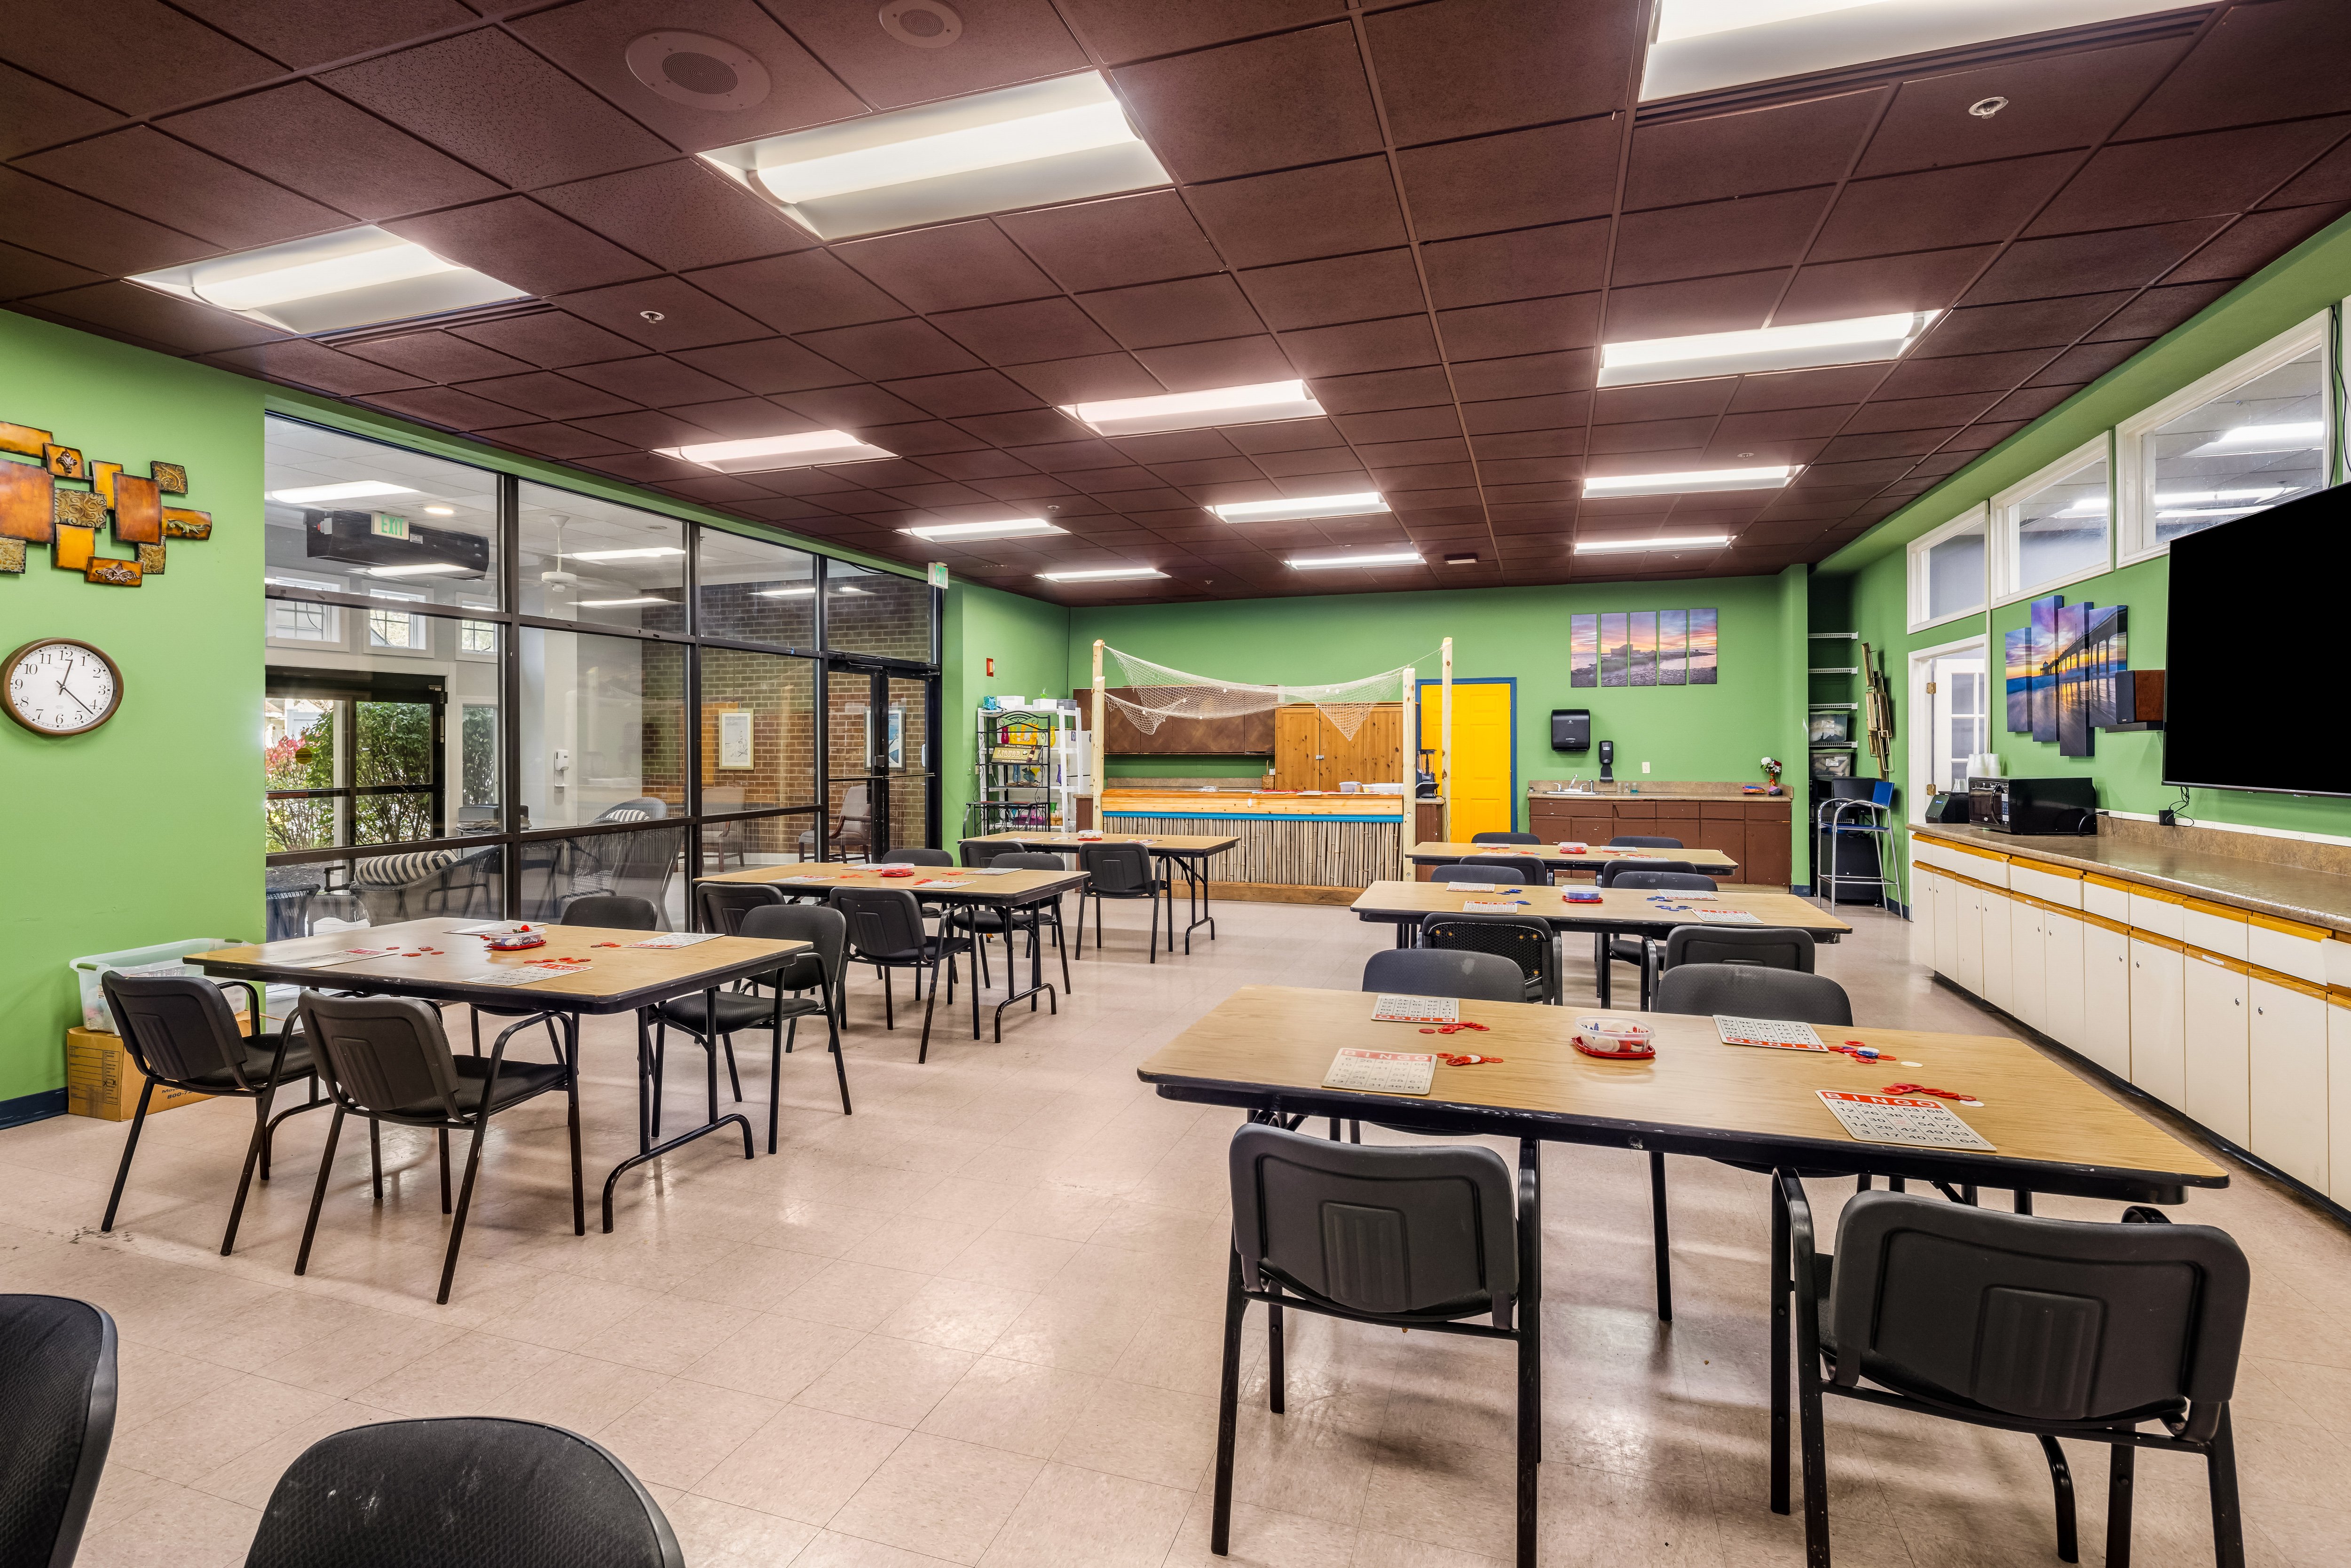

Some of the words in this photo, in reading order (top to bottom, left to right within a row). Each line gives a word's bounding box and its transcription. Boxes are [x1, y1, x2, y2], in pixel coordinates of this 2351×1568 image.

[381, 515, 404, 536] EXIT
[935, 565, 947, 586] EXIT
[39, 654, 52, 664] 11
[59, 650, 73, 661] 12
[80, 656, 87, 666] 1
[23, 664, 38, 675] 10
[93, 668, 101, 678] 2
[15, 679, 23, 690] 9
[98, 685, 106, 695] 3
[20, 696, 29, 707] 8
[89, 700, 97, 709] 4
[35, 709, 44, 719] 7
[56, 714, 63, 725] 6
[75, 711, 83, 721] 5
[997, 749, 1020, 758] LIQUOR
[1730, 1038, 1820, 1049] BINGO
[1344, 1049, 1428, 1060] BINGO
[1826, 1092, 1936, 1108] BINGO
